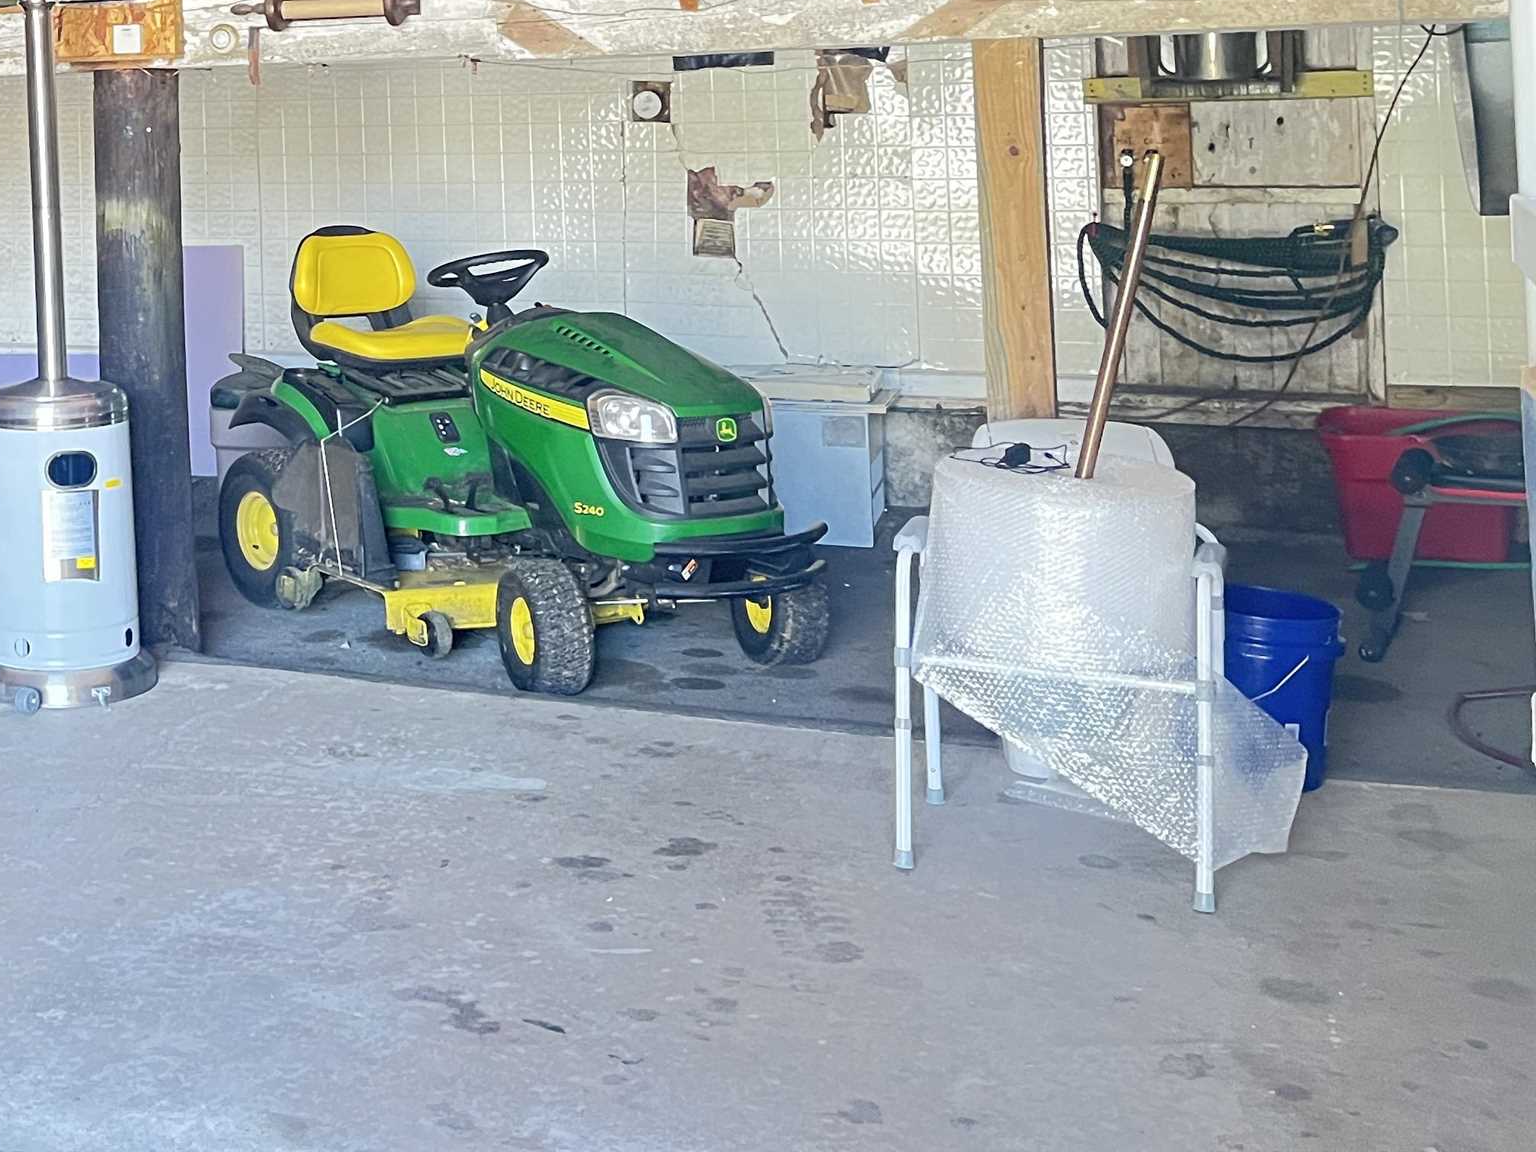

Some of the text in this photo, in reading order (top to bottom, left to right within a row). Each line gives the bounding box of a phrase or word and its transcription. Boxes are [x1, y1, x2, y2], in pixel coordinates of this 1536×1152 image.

[490, 377, 552, 417] JOHN DEERE
[573, 501, 605, 517] S240
